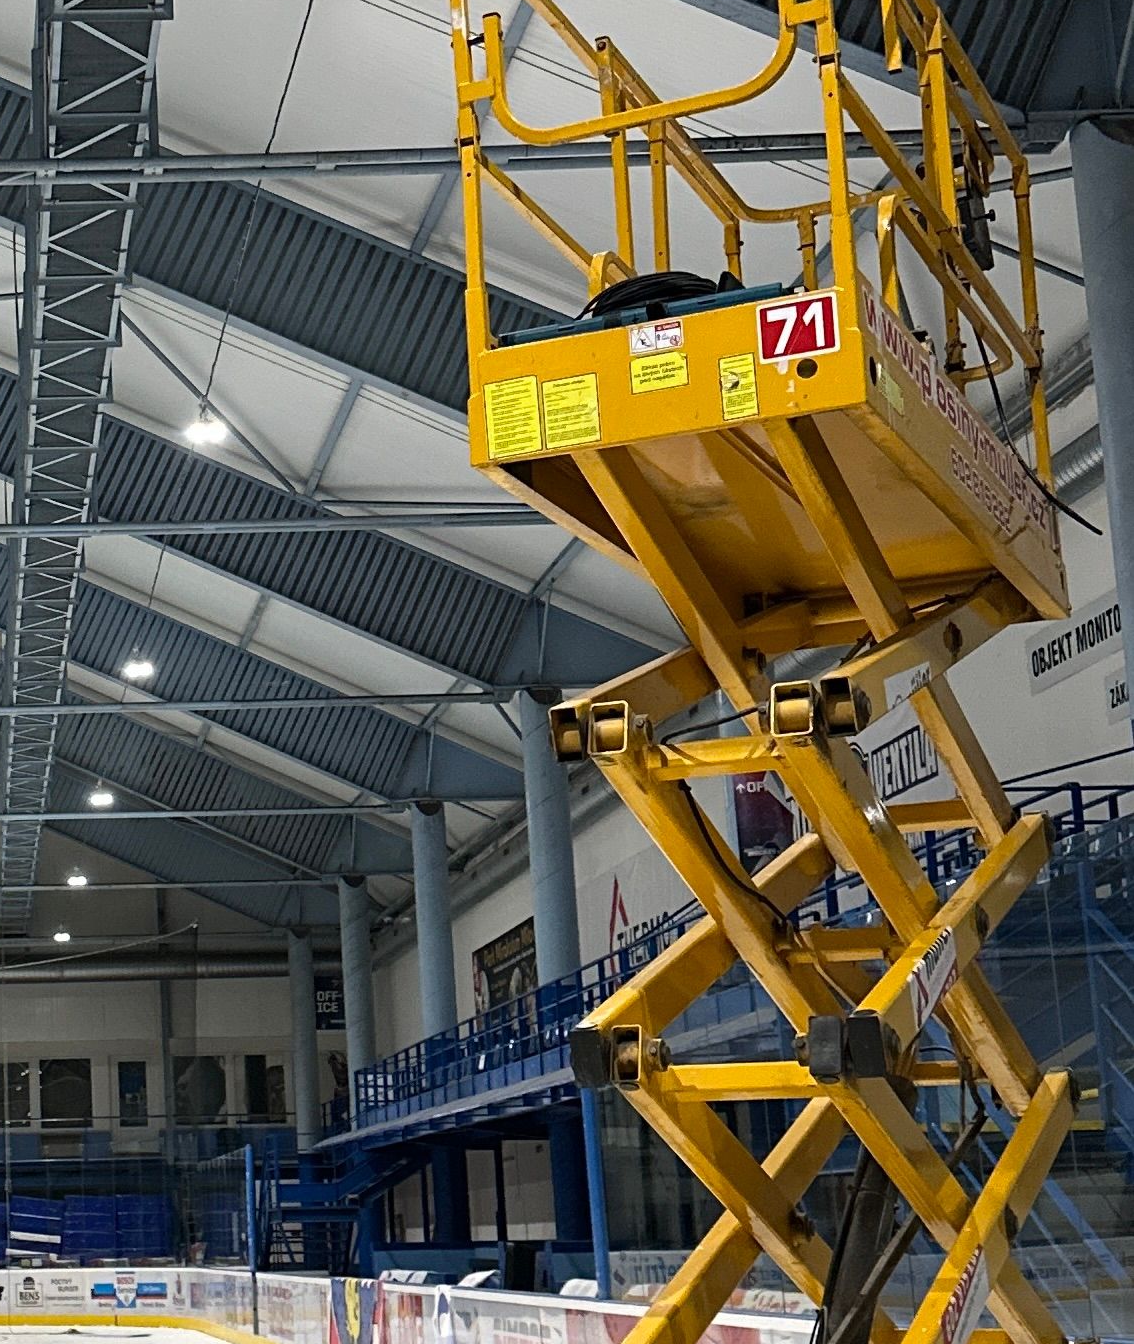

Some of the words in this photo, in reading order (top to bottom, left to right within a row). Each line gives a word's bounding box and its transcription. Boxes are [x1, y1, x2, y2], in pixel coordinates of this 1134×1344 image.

[766, 298, 829, 355] 71
[1032, 631, 1072, 677] OBJEKT
[1075, 603, 1122, 654] MONITO
[316, 1002, 338, 1013] ICE
